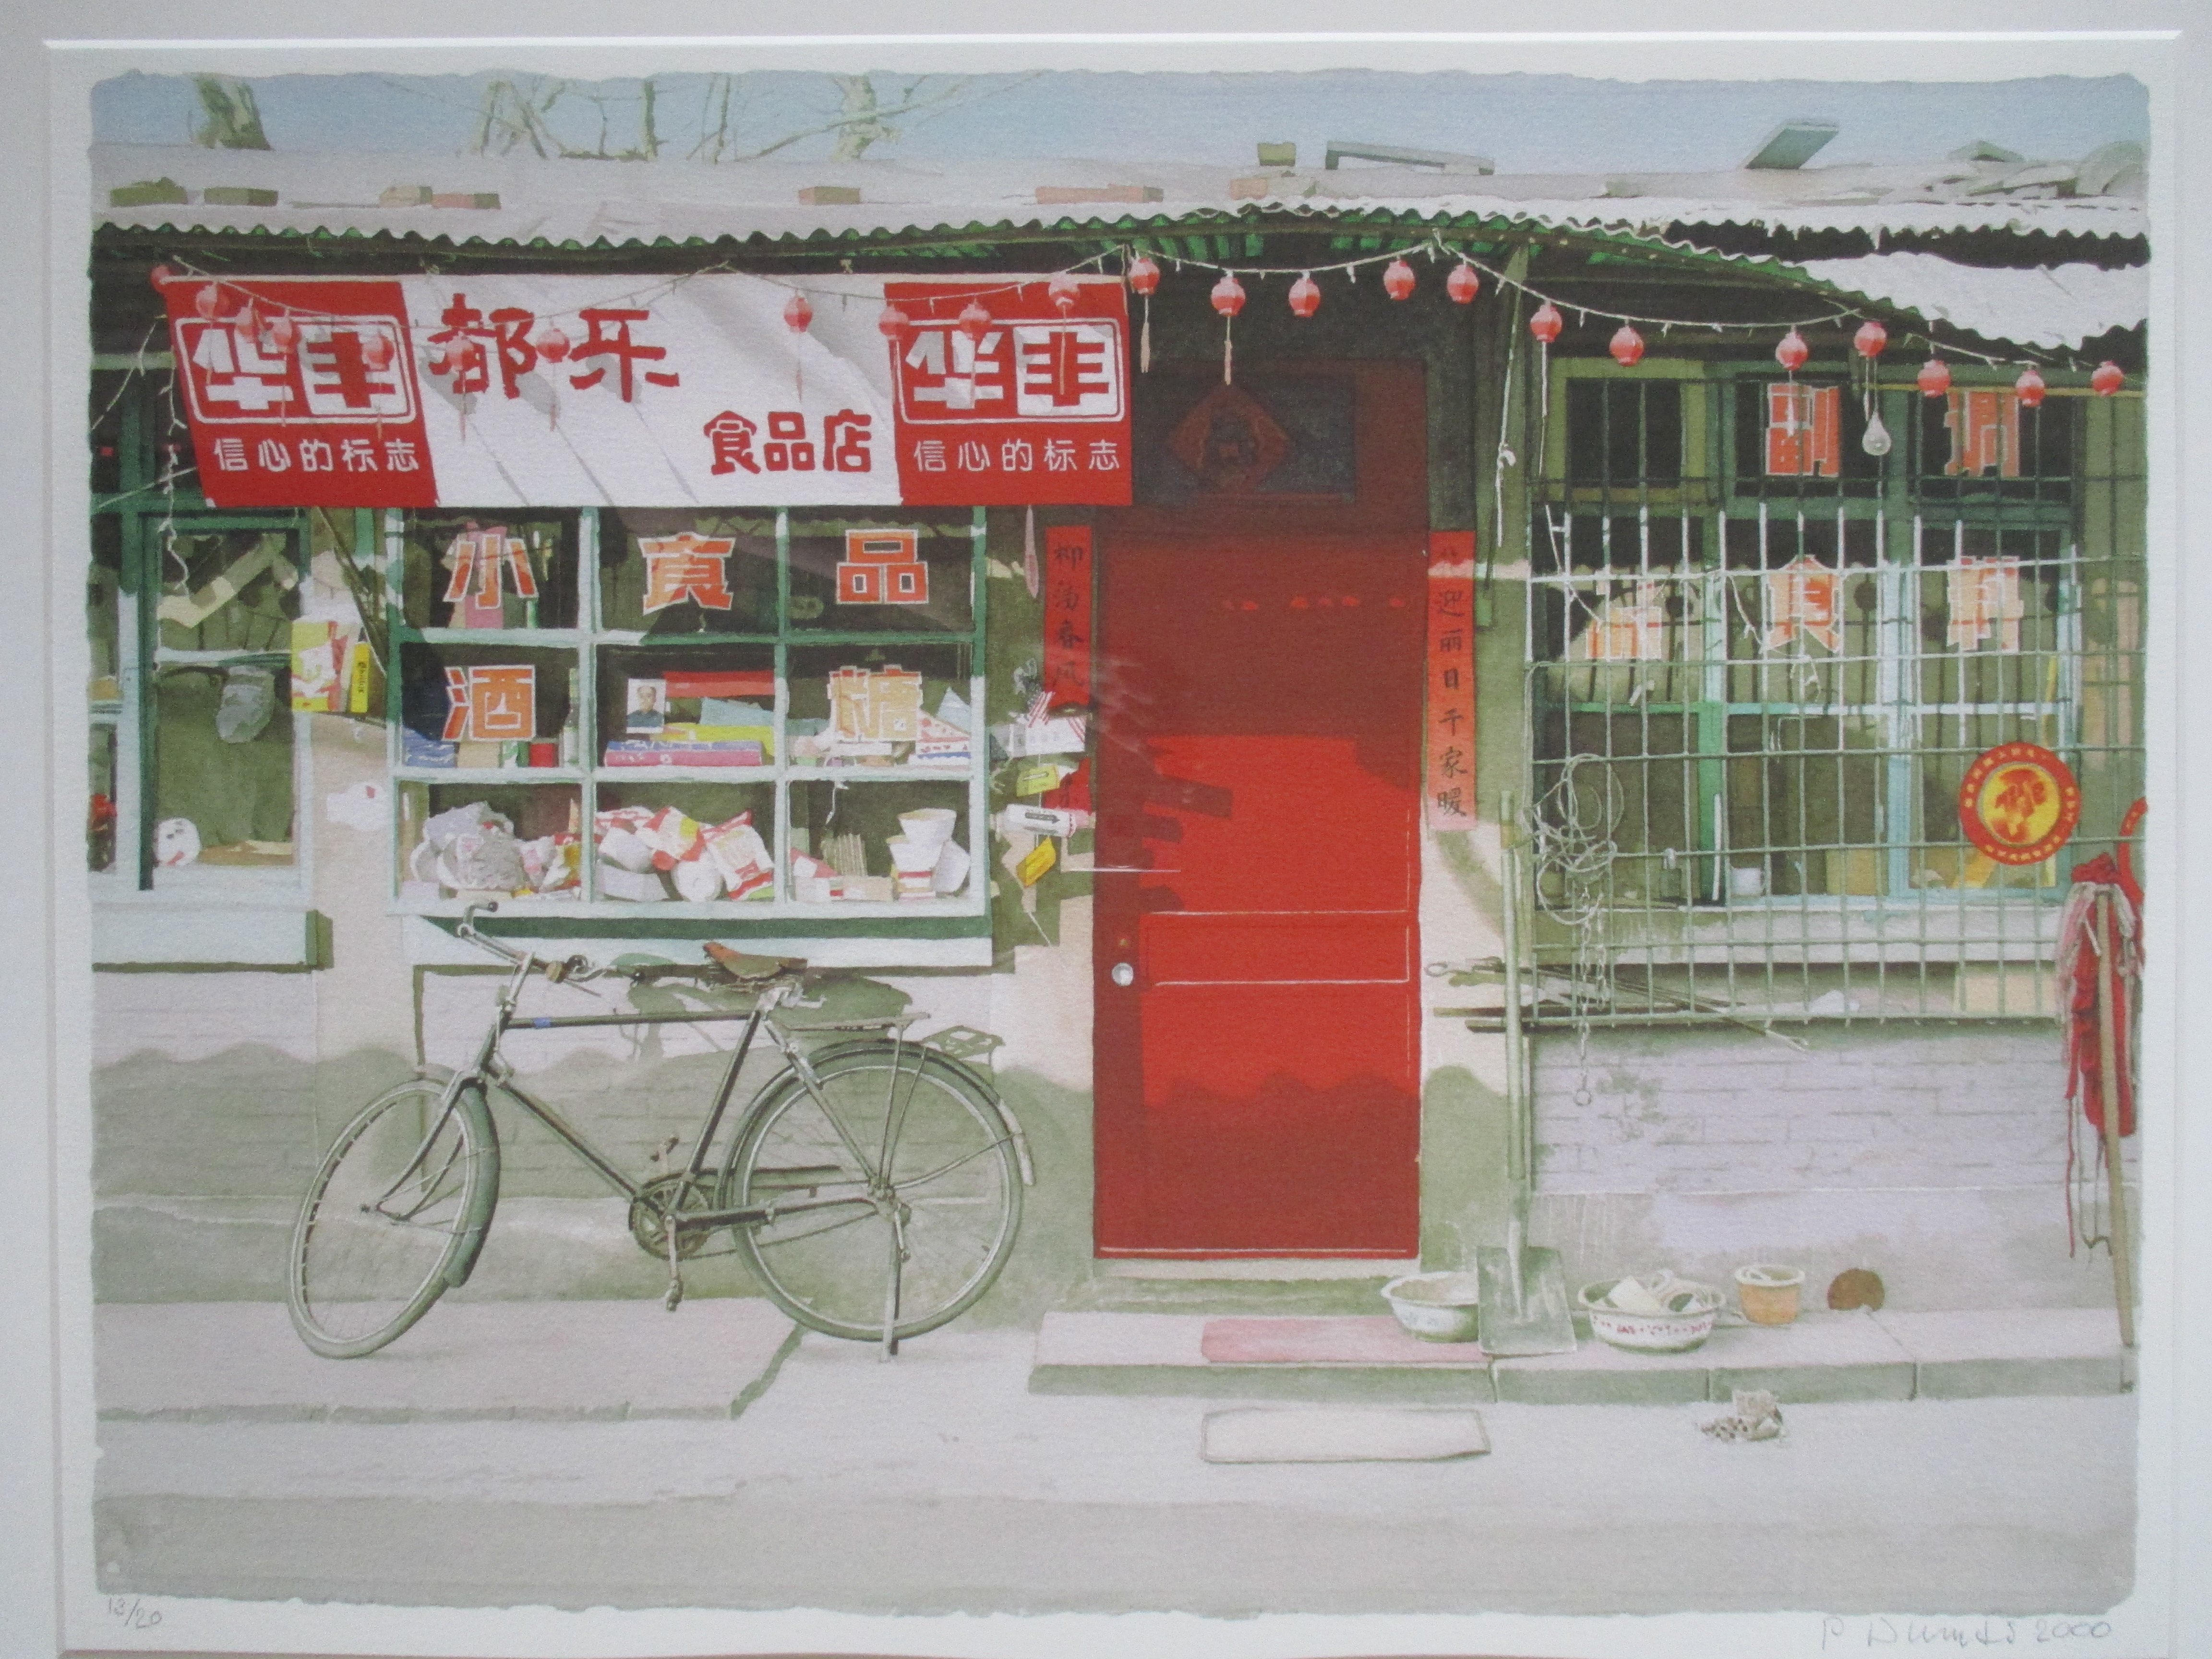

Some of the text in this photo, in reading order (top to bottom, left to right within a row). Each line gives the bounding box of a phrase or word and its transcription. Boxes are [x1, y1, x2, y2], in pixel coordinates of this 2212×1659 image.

[426, 292, 681, 403] 都乐
[213, 438, 420, 472] 信心的标志
[704, 409, 872, 475] 食品店
[914, 438, 1120, 473] 信心的标志
